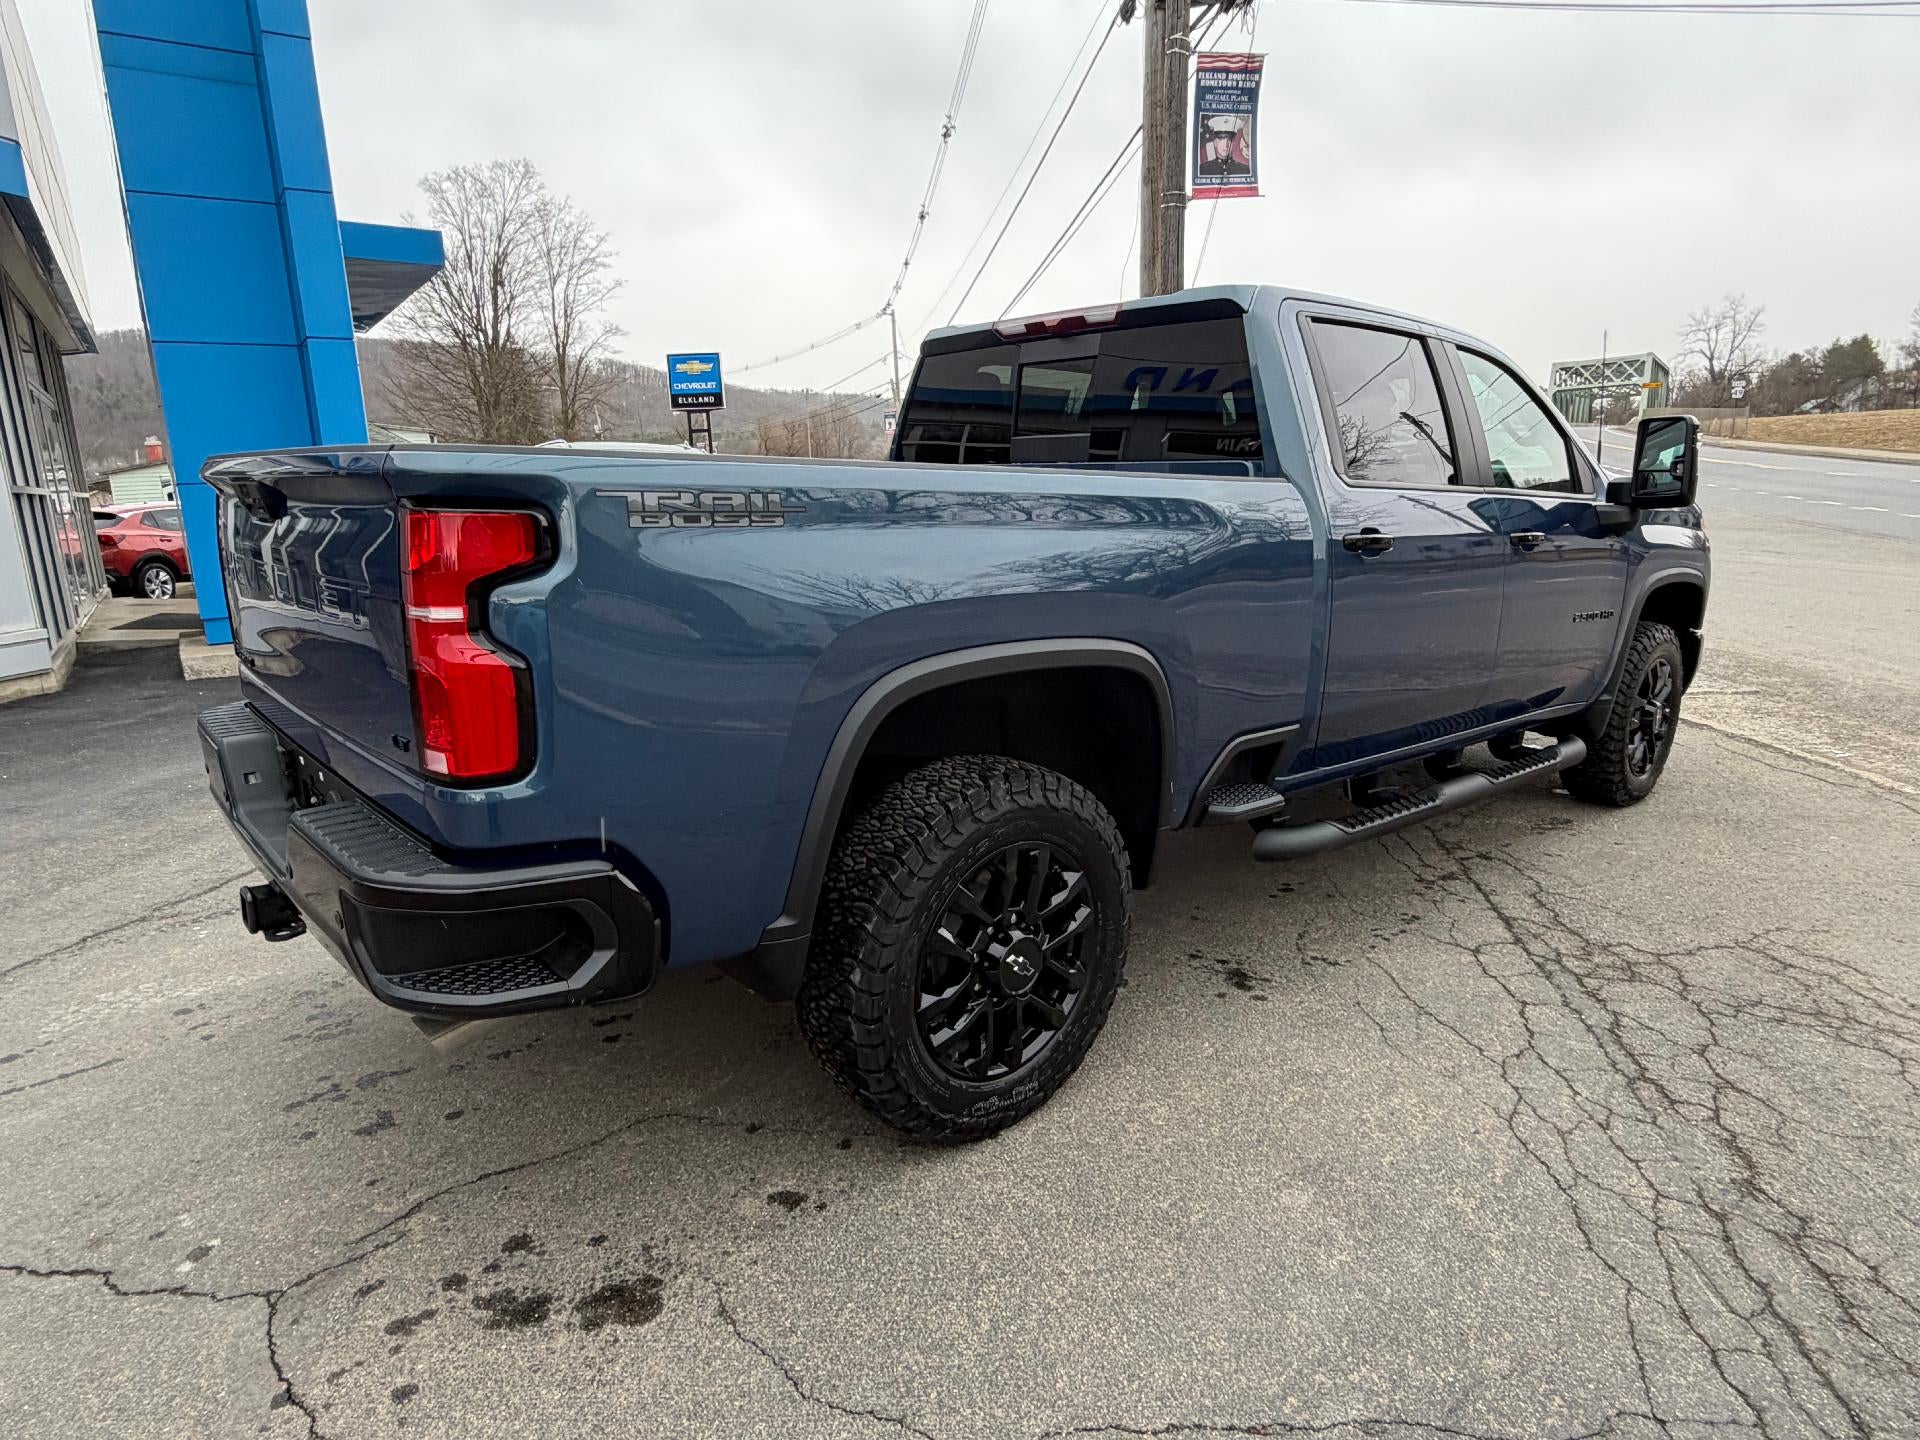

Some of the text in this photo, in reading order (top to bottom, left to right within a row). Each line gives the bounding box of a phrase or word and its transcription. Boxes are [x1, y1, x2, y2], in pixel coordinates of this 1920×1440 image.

[1212, 102, 1233, 110] MARINE
[673, 382, 717, 390] CHEVROLET
[678, 396, 715, 404] ELKLAND
[595, 490, 807, 513] TRAIL
[627, 511, 785, 529] BOSS
